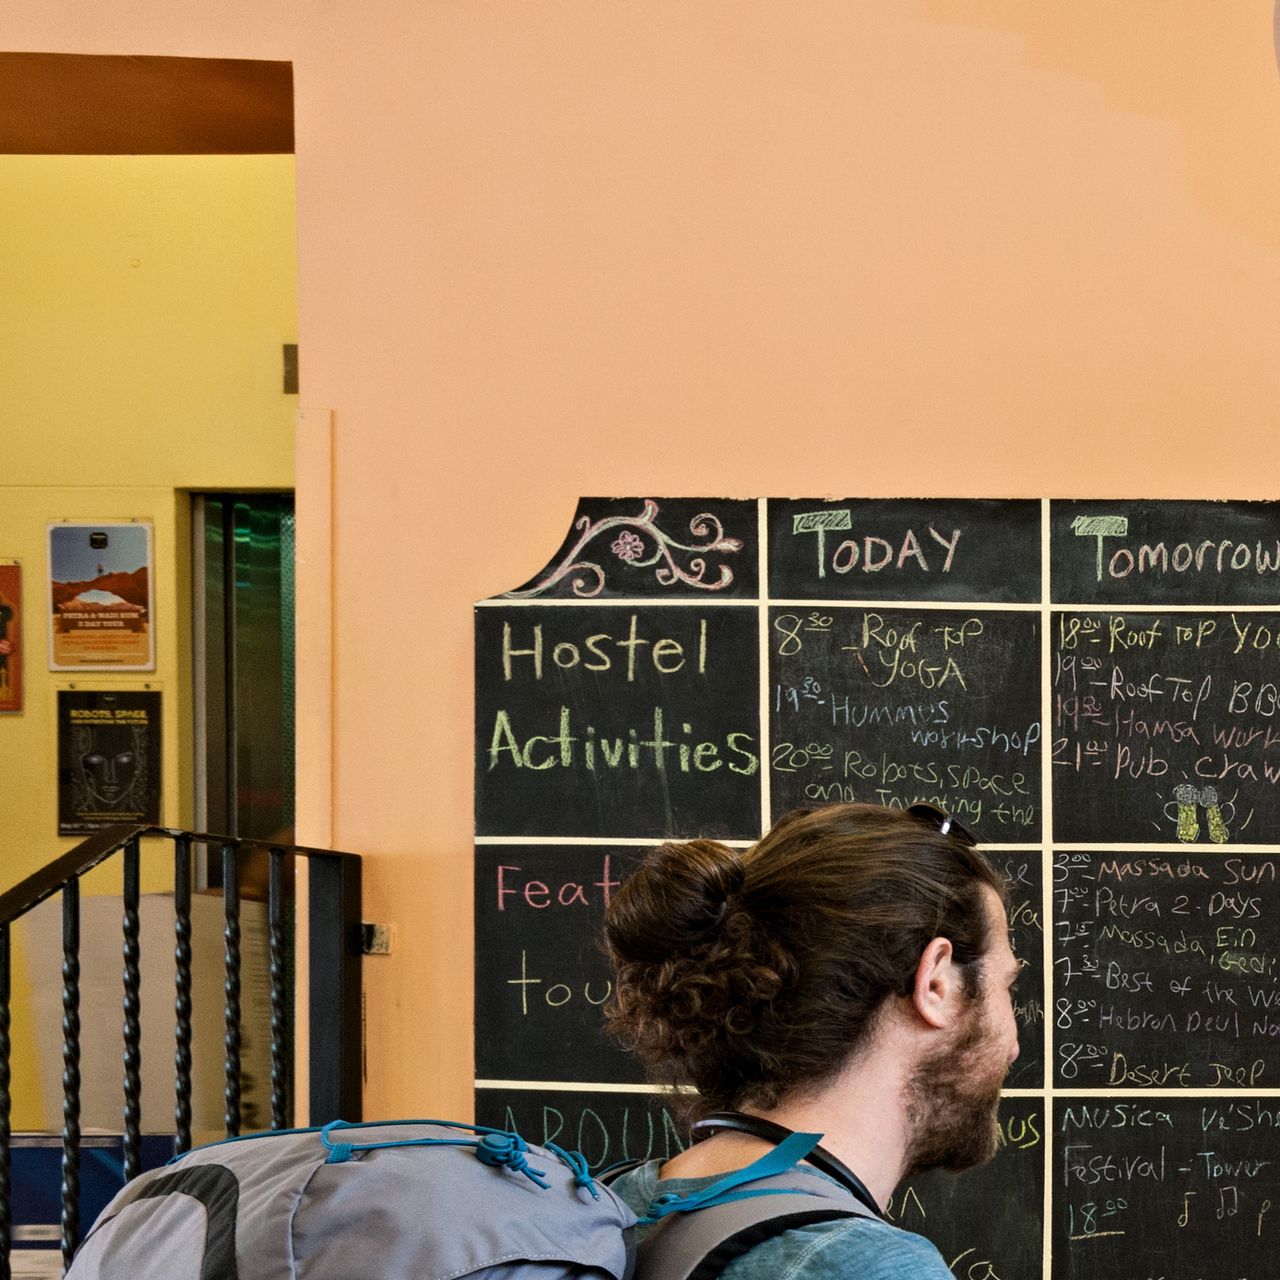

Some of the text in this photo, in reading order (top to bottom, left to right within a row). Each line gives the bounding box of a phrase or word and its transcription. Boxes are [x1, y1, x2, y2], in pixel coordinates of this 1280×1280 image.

[503, 614, 706, 681] Hostel
[488, 705, 759, 776] Activities
[990, 802, 1034, 826] the
[1095, 886, 1161, 918] Petra
[1169, 976, 1192, 997] of
